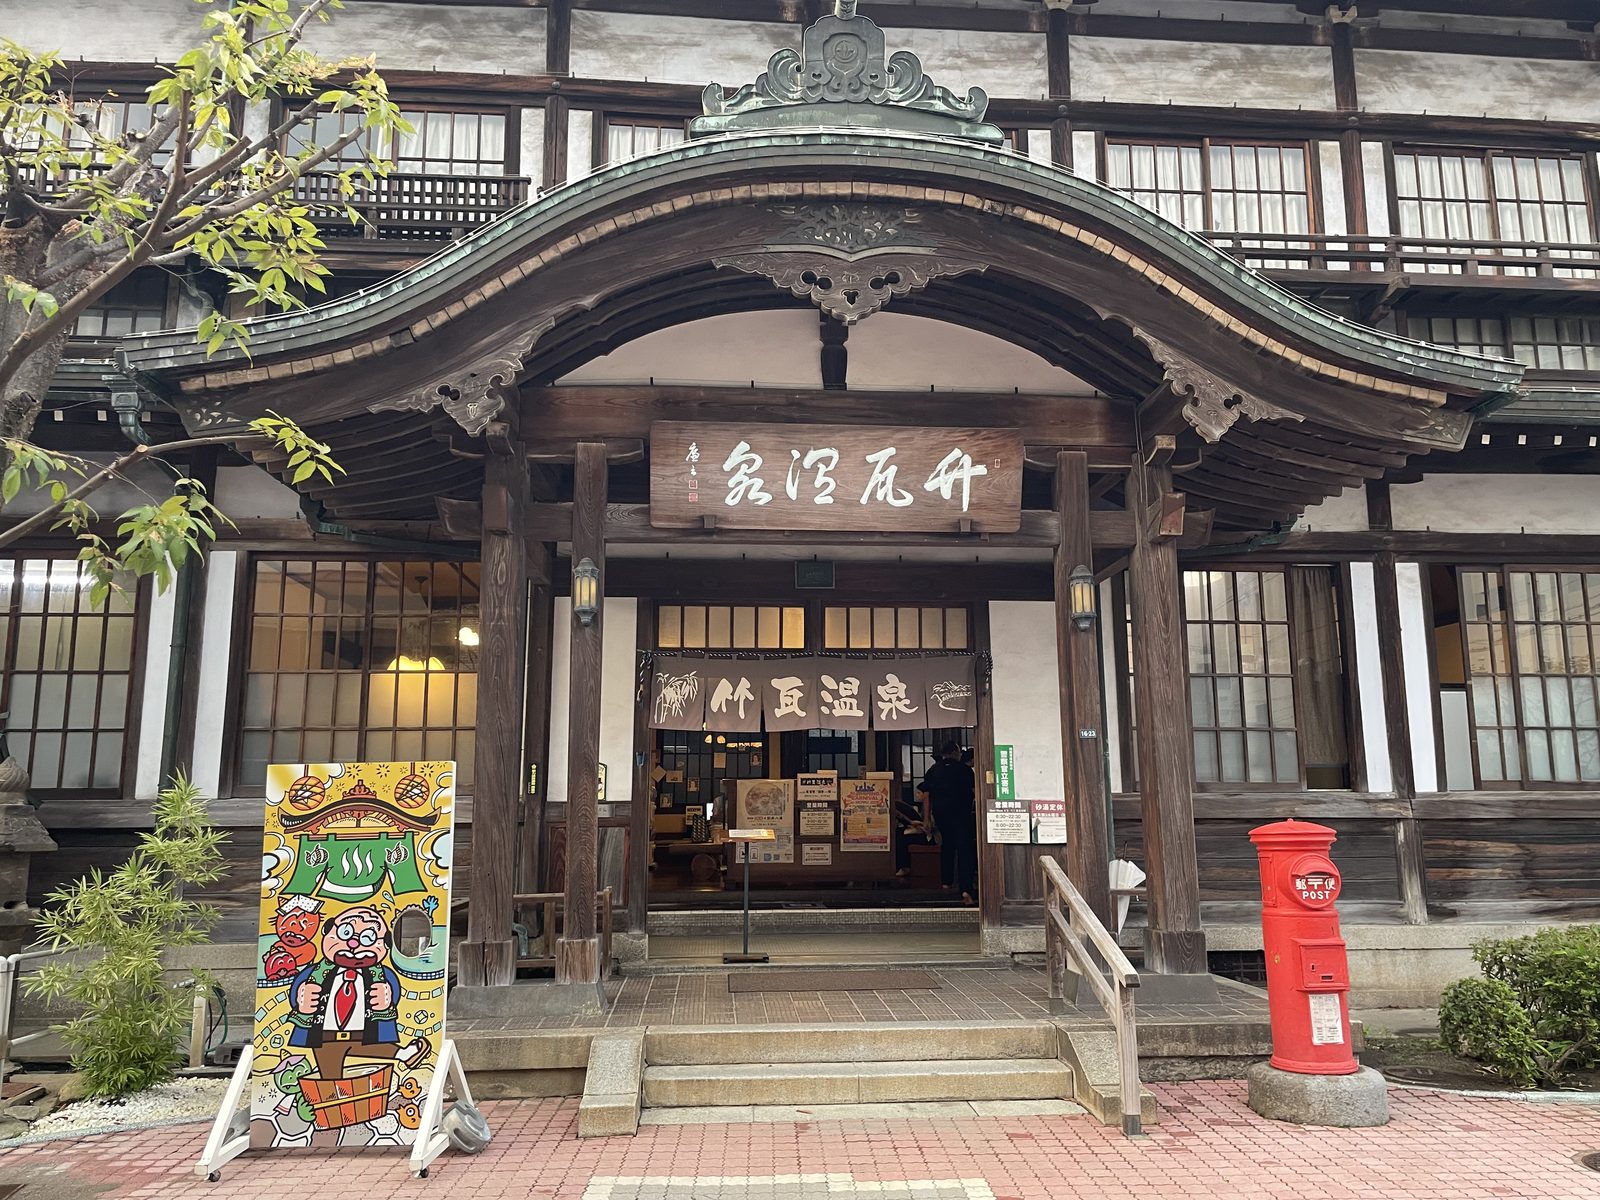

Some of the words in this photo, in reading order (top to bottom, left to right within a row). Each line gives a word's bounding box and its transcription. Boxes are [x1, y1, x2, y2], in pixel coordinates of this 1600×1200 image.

[711, 673, 919, 721] 竹瓦温泉
[1302, 890, 1330, 900] POST
